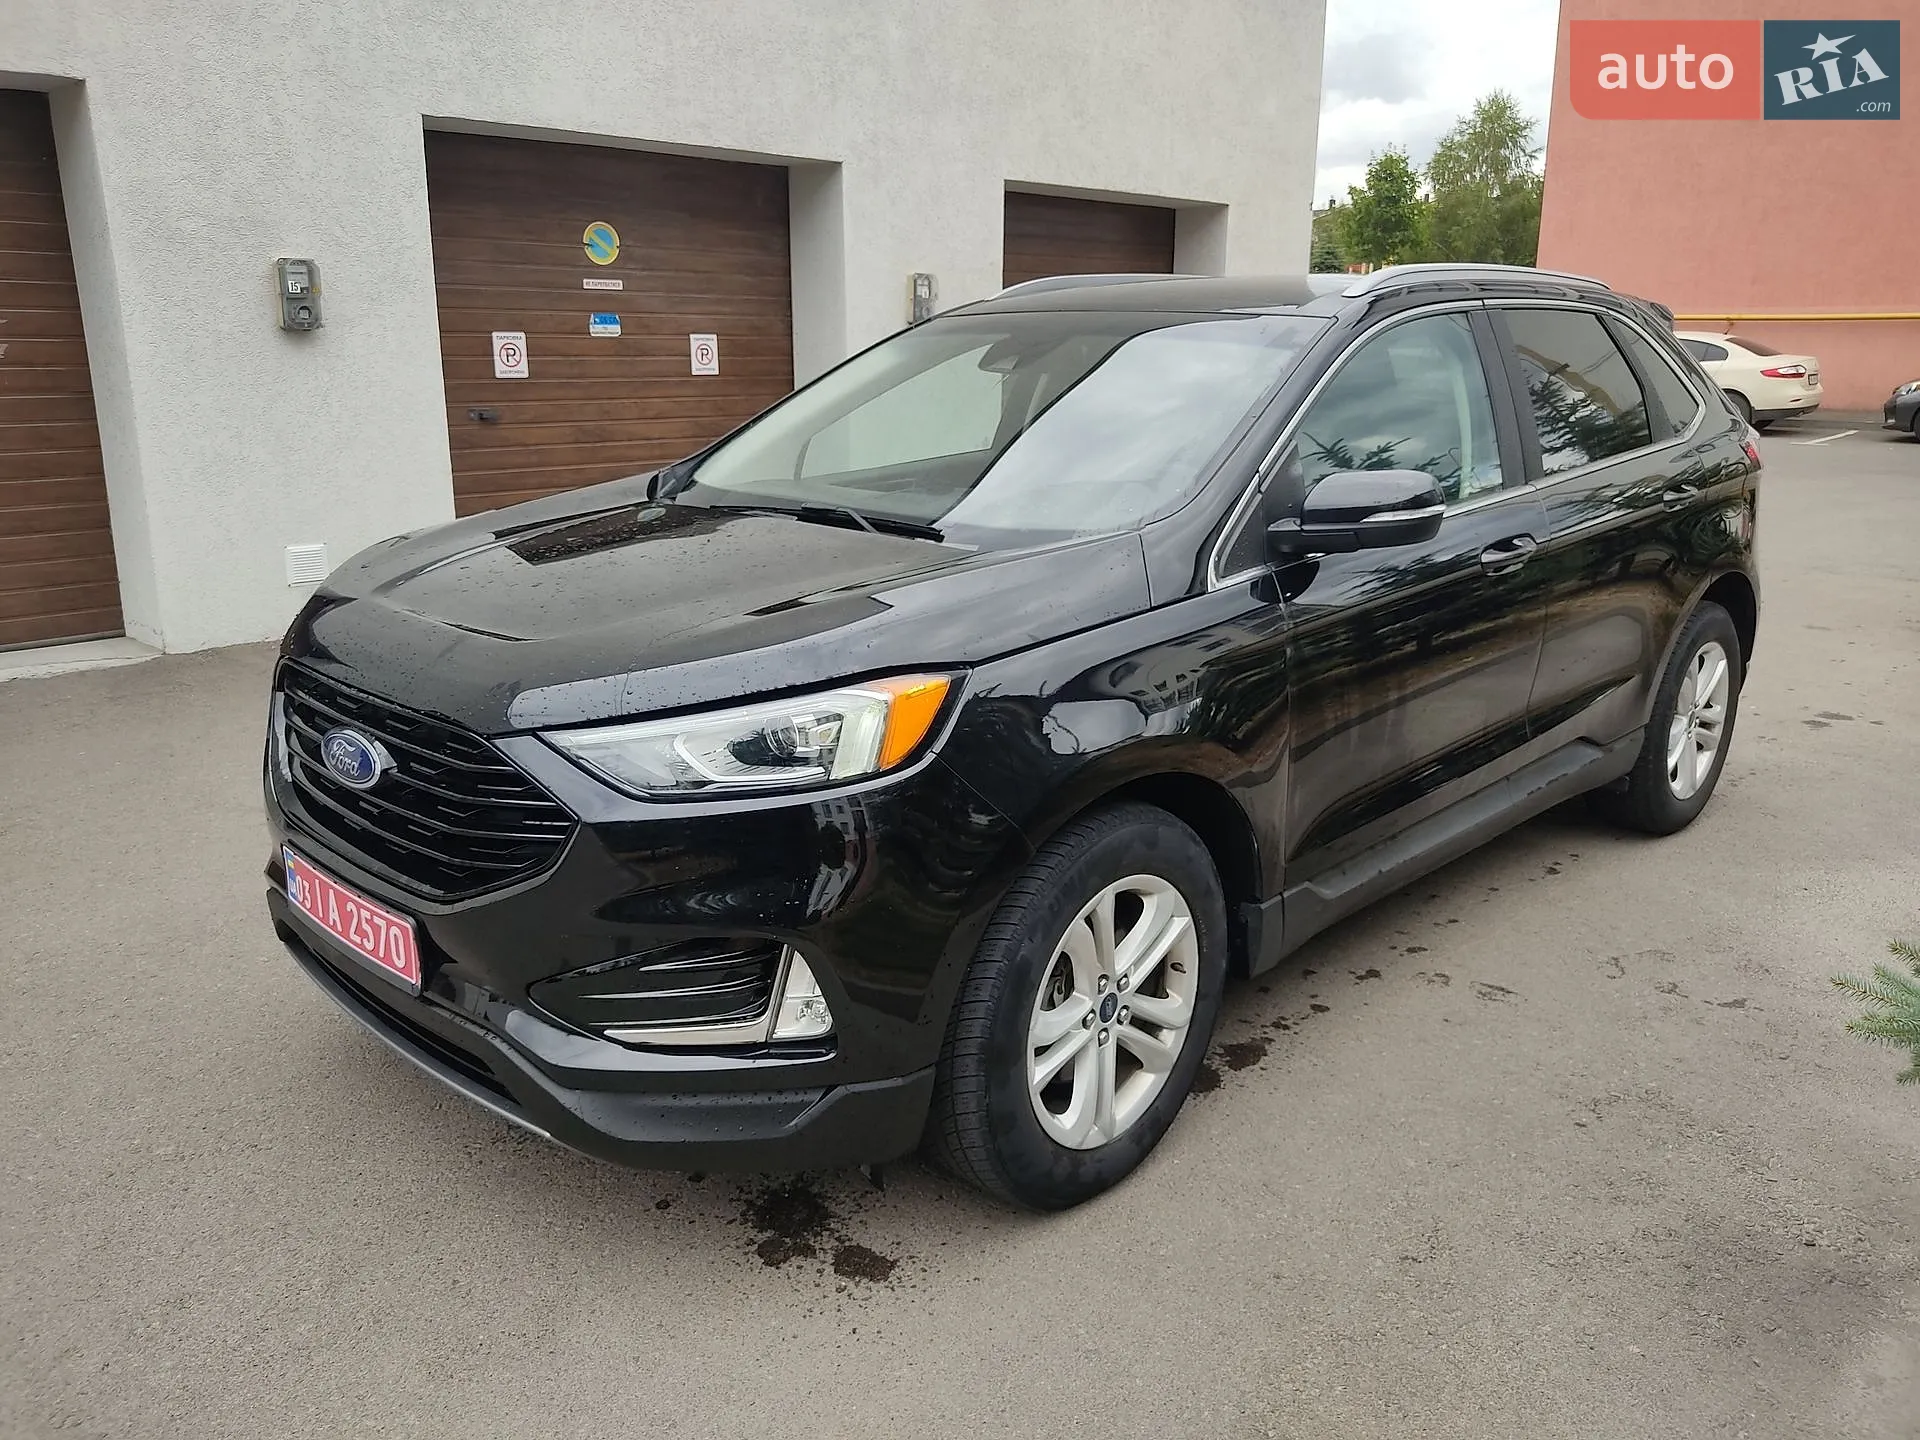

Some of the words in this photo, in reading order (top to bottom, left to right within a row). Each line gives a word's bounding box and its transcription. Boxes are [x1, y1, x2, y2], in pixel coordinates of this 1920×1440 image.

[290, 282, 299, 292] 15
[329, 739, 363, 776] Ford
[295, 875, 312, 910] 03
[346, 901, 406, 969] 2570
